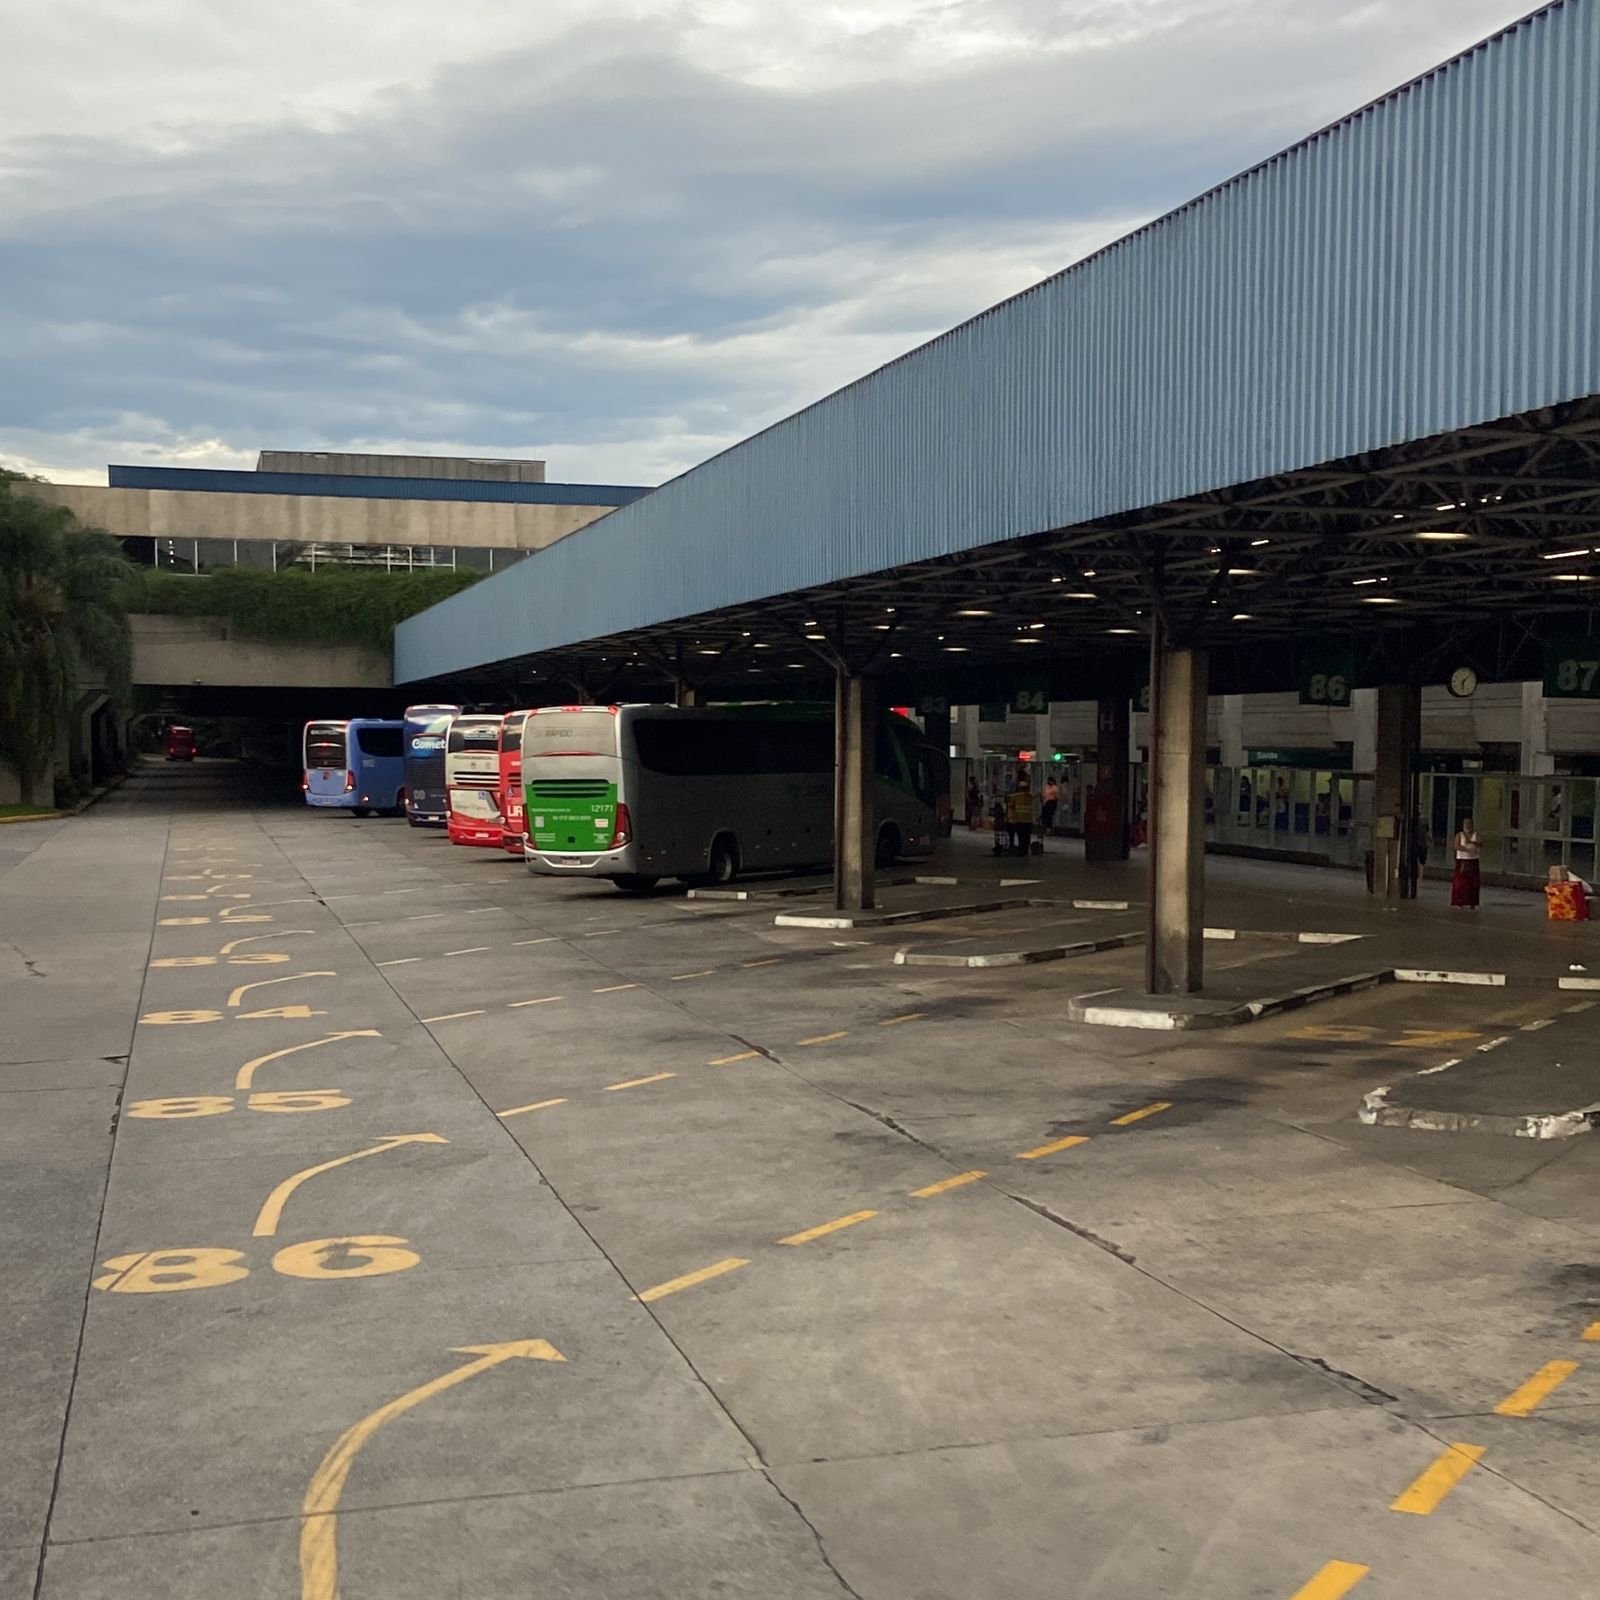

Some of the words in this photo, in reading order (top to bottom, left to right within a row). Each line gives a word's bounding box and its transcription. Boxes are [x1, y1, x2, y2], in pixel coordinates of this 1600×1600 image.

[1557, 659, 1600, 692] 87
[1309, 673, 1348, 702] 86
[1016, 690, 1046, 712] 84
[412, 738, 447, 750] Comet
[591, 804, 614, 813] 12171
[149, 952, 291, 967] 83
[138, 1004, 329, 1026] 84
[126, 1088, 353, 1120] 85
[93, 1234, 422, 1294] 86
